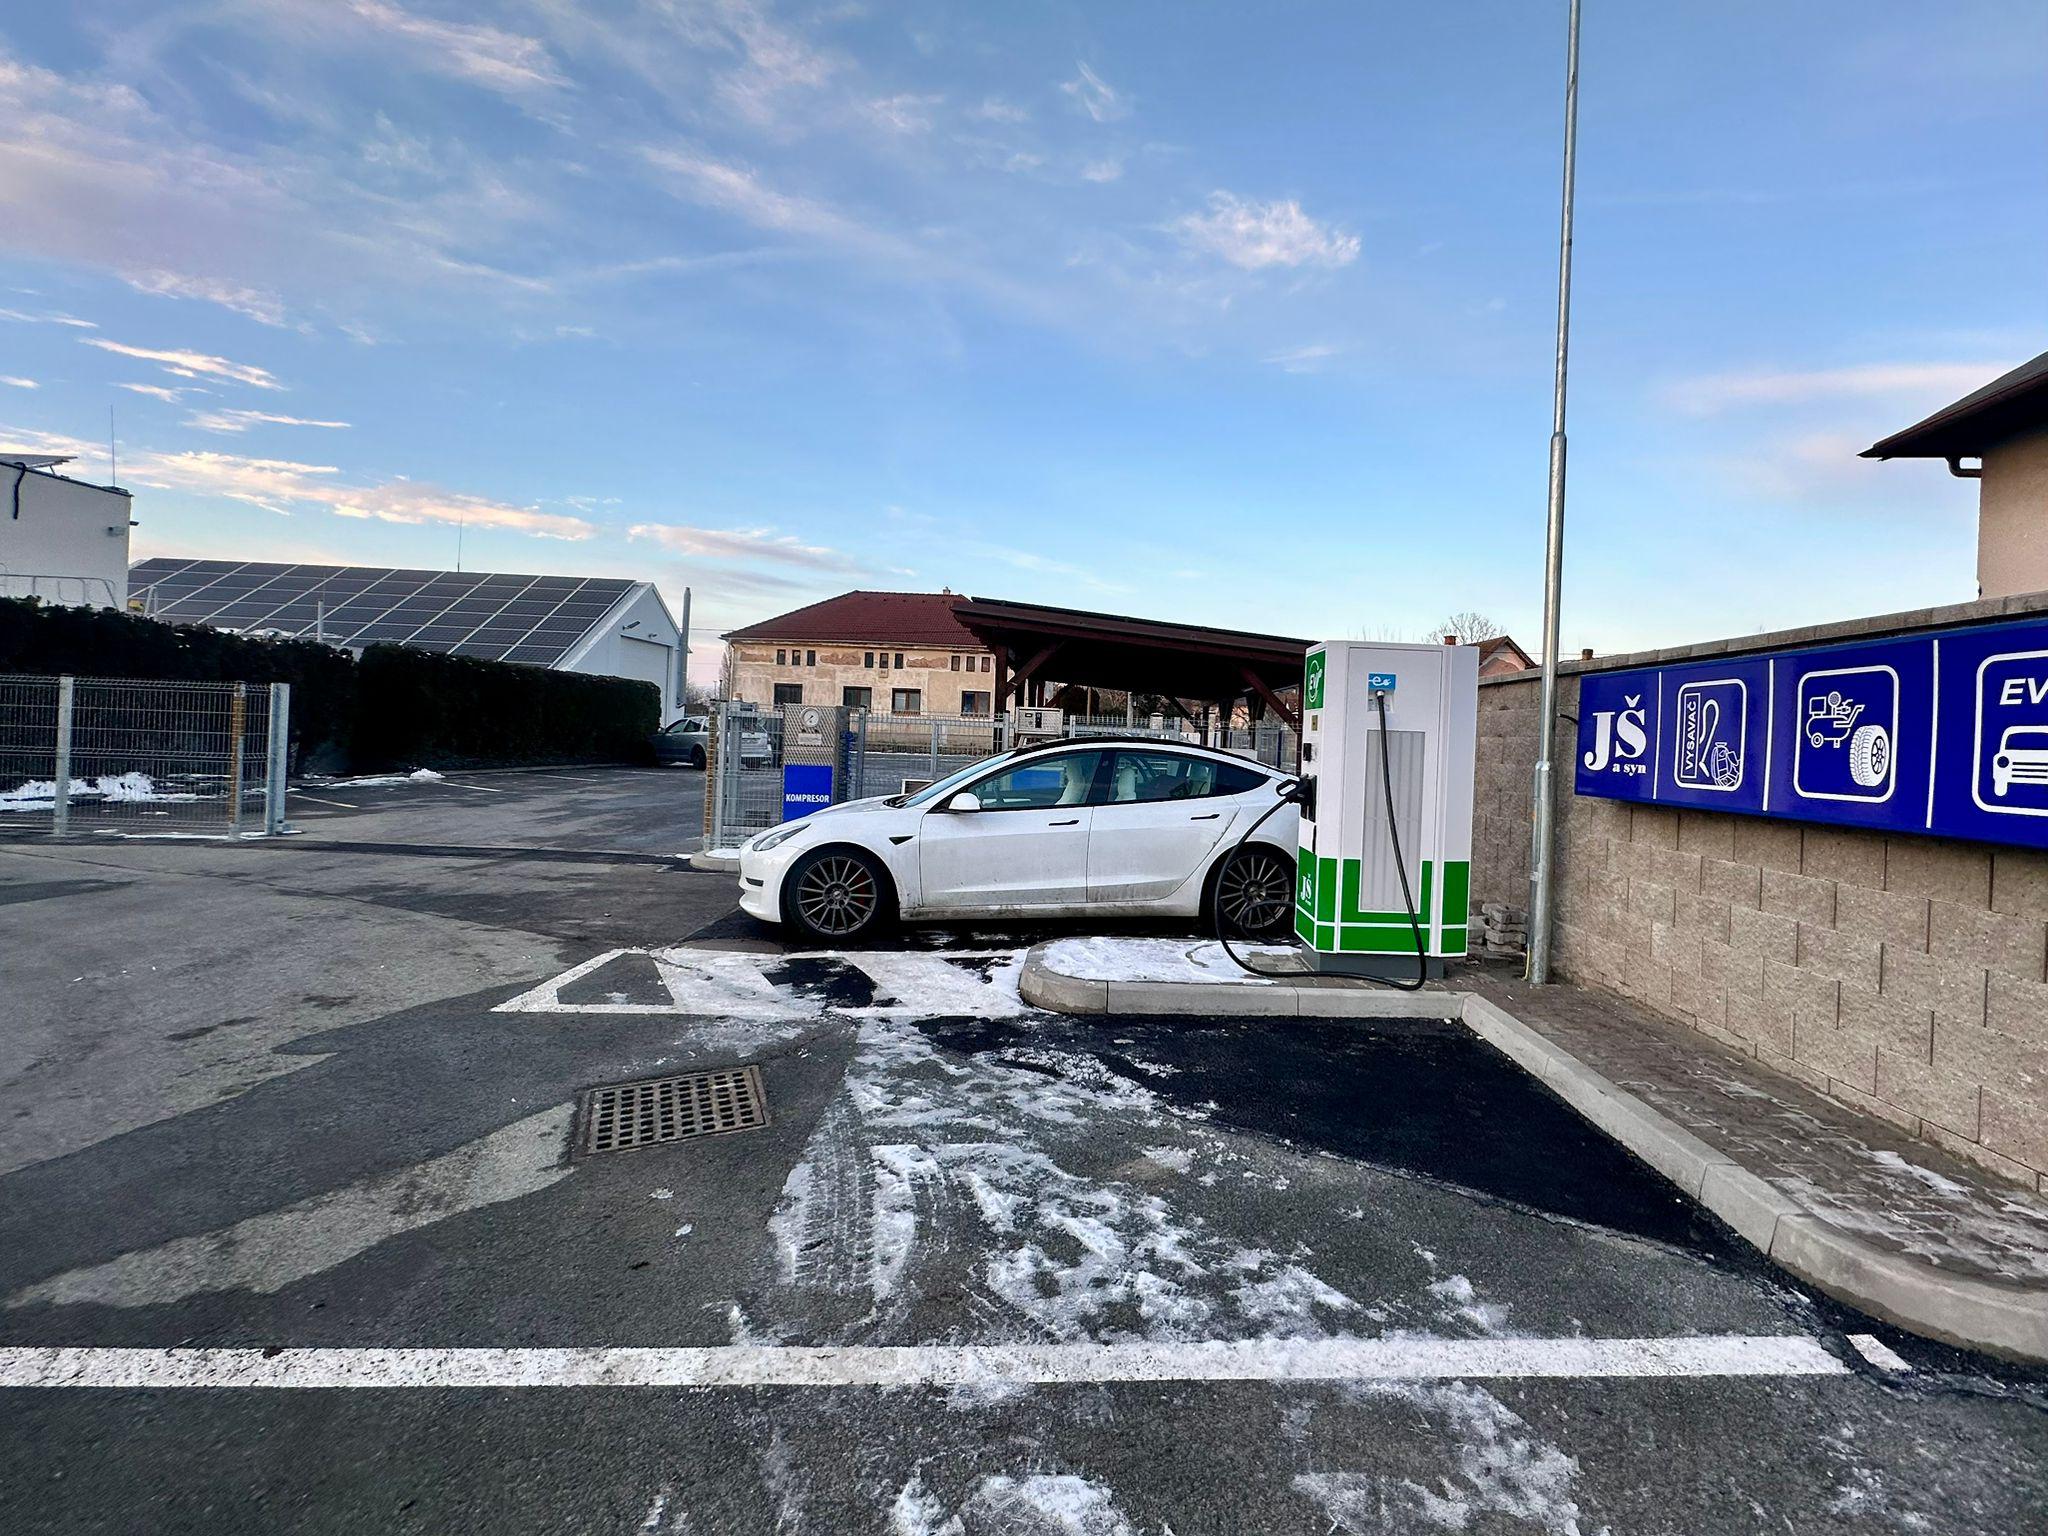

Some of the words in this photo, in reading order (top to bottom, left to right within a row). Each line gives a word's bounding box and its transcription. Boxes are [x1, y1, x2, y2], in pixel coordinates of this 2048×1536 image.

[1584, 694, 1647, 771] JŠ
[1684, 700, 1697, 771] VYSAVAČ
[1612, 763, 1621, 773] a
[1623, 763, 1647, 776] syn
[785, 793, 830, 803] KOMPRESOR
